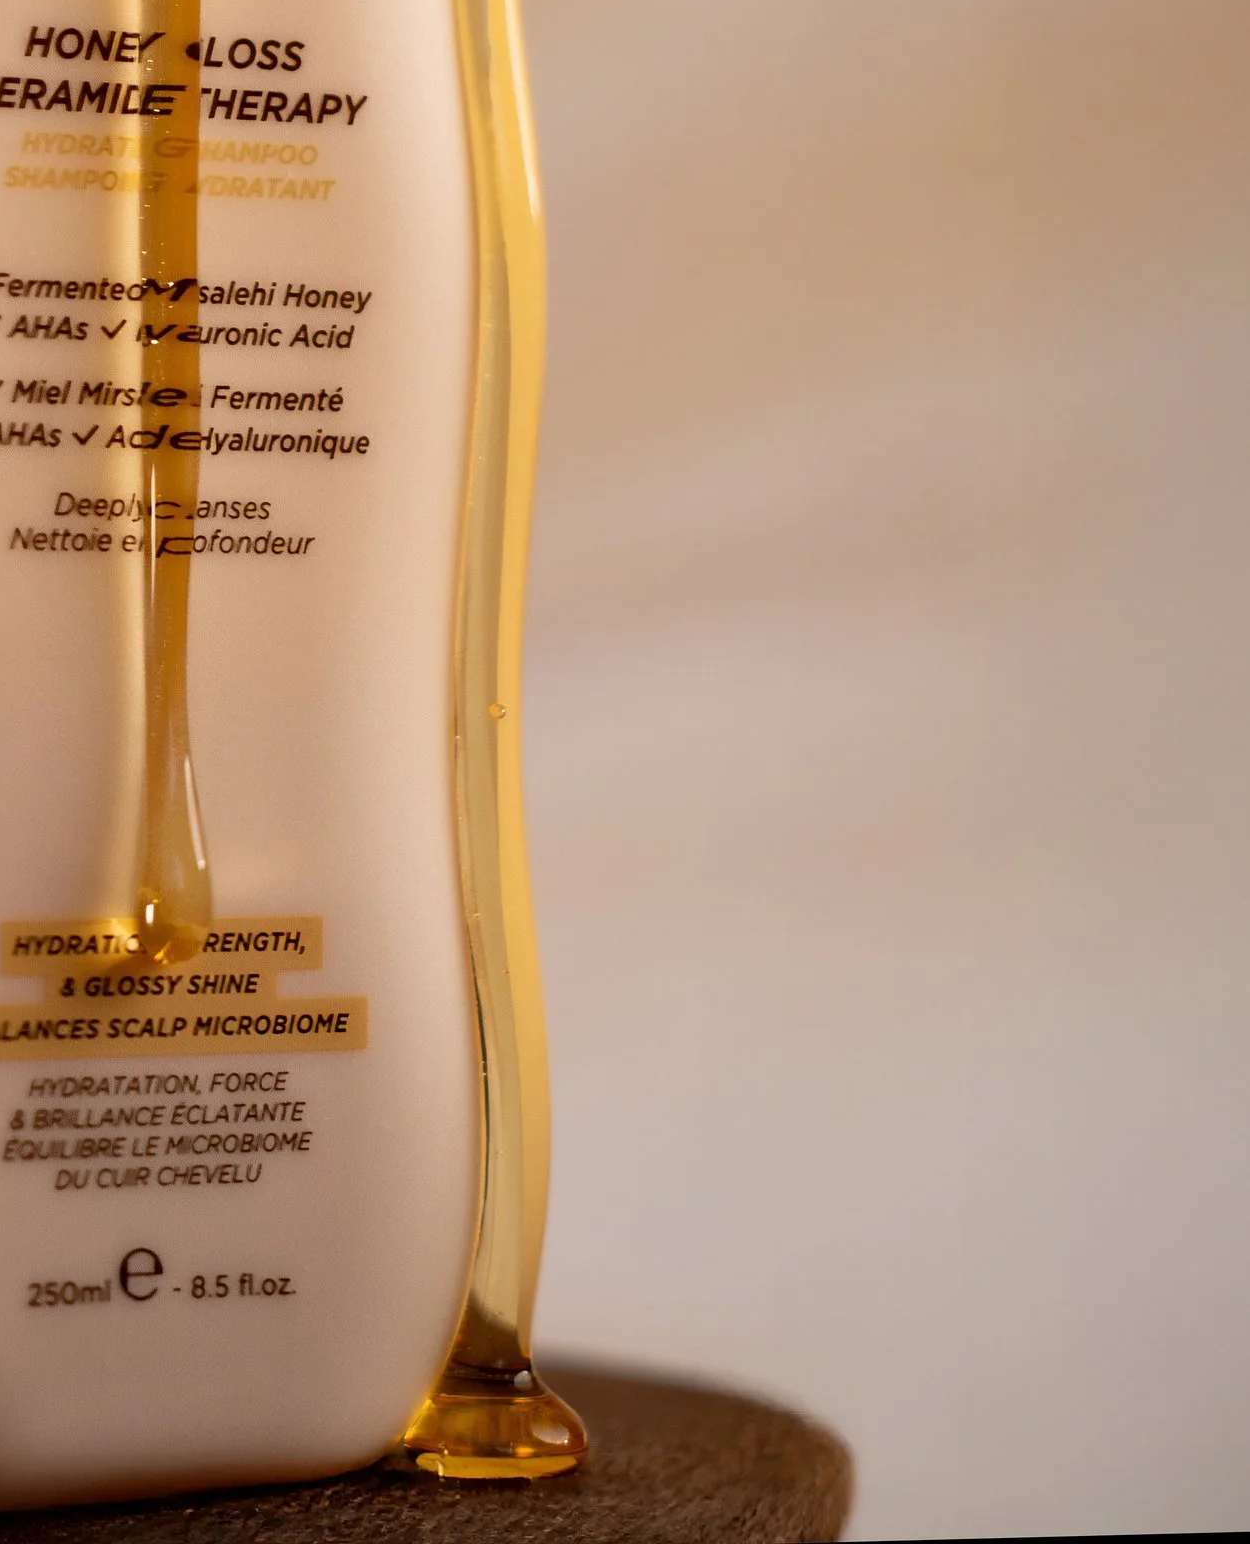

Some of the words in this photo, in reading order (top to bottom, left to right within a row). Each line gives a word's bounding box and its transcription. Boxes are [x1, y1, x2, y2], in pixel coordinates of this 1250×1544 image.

[24, 26, 166, 64] HONEY
[186, 38, 305, 71] LOSS
[200, 140, 318, 167] HAMPOO
[144, 278, 276, 307] Msalehi
[282, 284, 372, 314] Honey
[7, 316, 89, 340] AHAs
[289, 324, 355, 349] Acid
[11, 379, 70, 405] Miel
[210, 385, 344, 412] Fermenté
[9, 527, 113, 553] Nettoie
[60, 979, 76, 997] &
[84, 975, 182, 997] GLOSSY
[186, 973, 260, 994] SHINE
[106, 1017, 187, 1039] SCALP
[192, 1012, 351, 1037] MICROBIOME
[28, 1073, 201, 1098] HYDRATATION,
[209, 1071, 289, 1093] FORCE
[9, 1108, 25, 1130] &
[32, 1105, 166, 1130] BRILLANCE
[170, 1101, 307, 1127] ÉCLATANTE
[2, 1137, 127, 1162] ÉQUILIBRE
[131, 1135, 160, 1158] LE
[165, 1131, 313, 1156] MICROBIOME
[54, 1167, 91, 1191] DU
[95, 1166, 150, 1189] CUIR
[156, 1162, 263, 1188] CHEVELU
[27, 1279, 112, 1308] 250ml
[191, 1273, 230, 1300] 8.5
